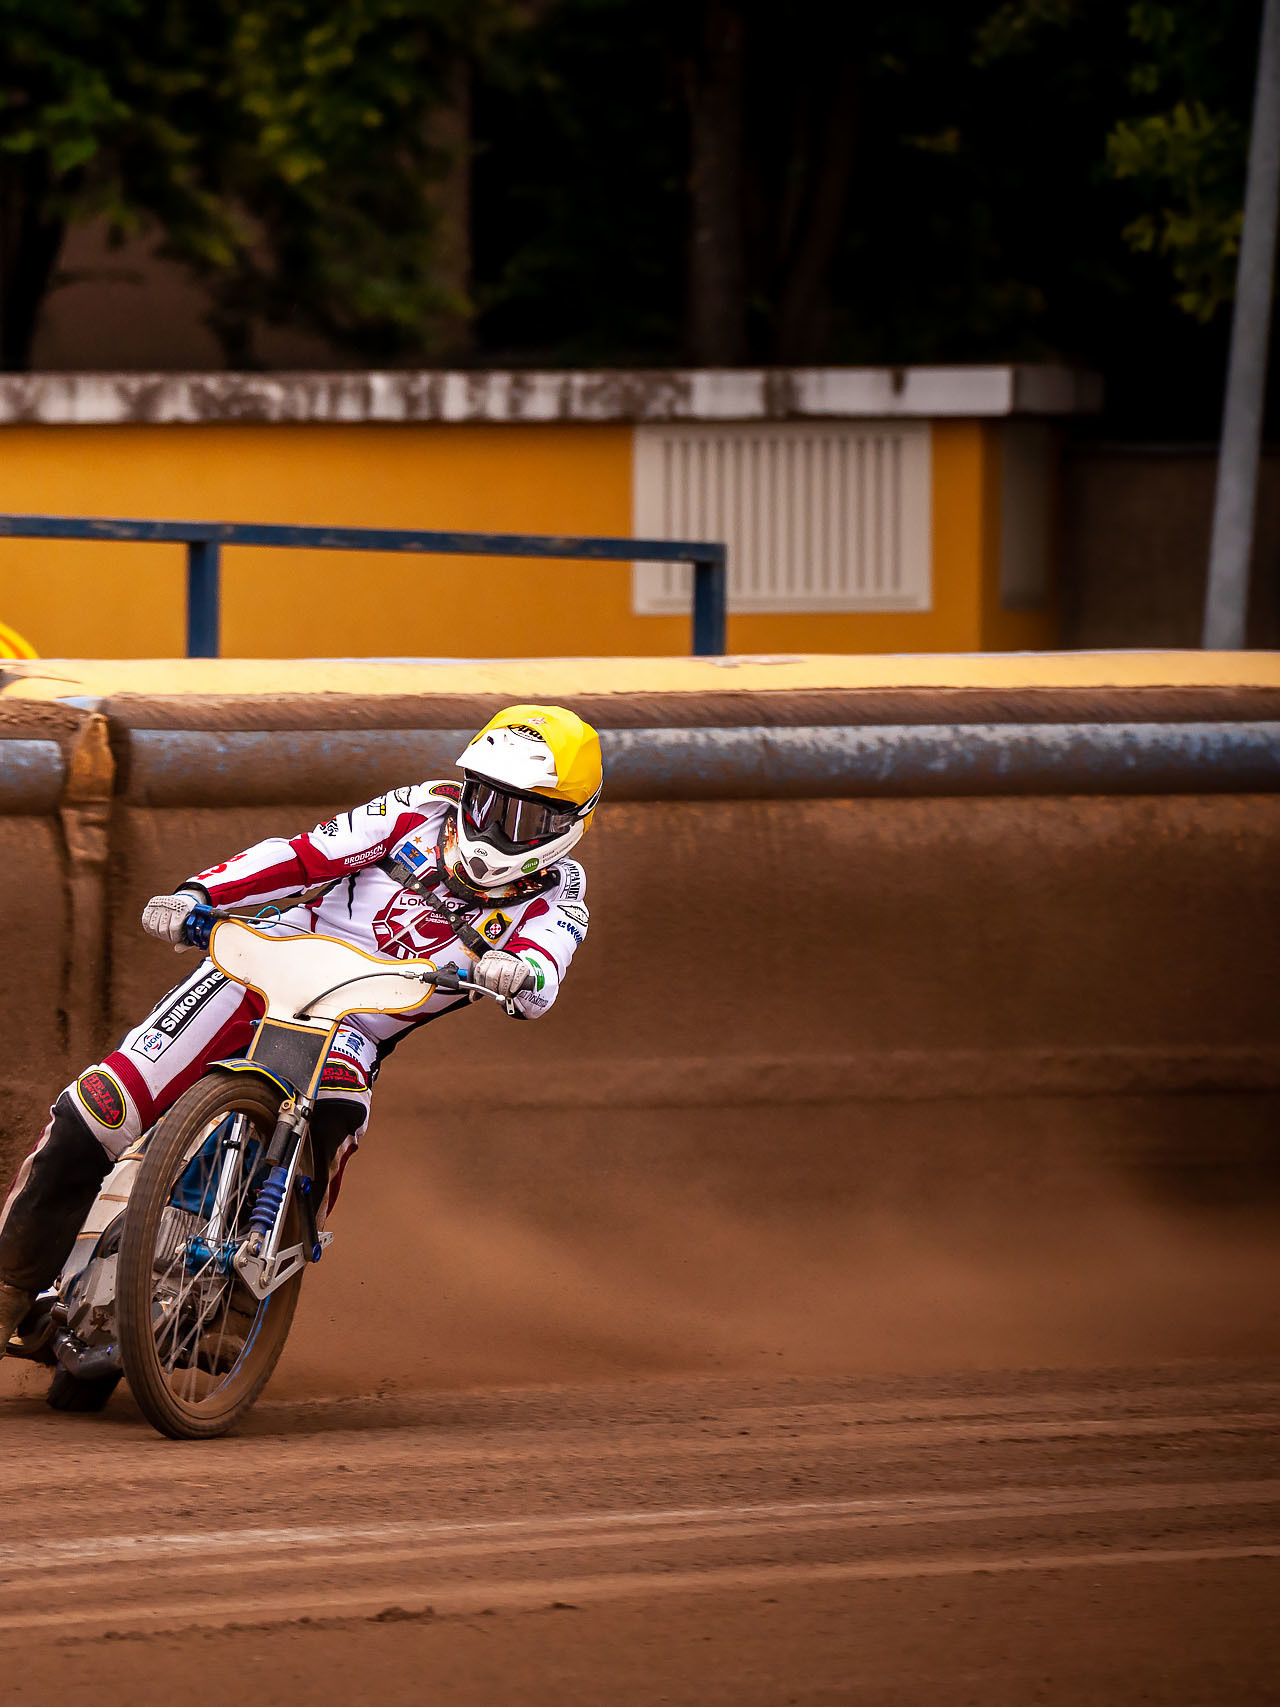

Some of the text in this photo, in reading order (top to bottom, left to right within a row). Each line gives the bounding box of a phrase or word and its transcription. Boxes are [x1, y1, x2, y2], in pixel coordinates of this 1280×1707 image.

[161, 971, 225, 1032] Silkolene
[143, 1032, 162, 1052] FUCHS
[87, 1073, 121, 1121] HEJLA
